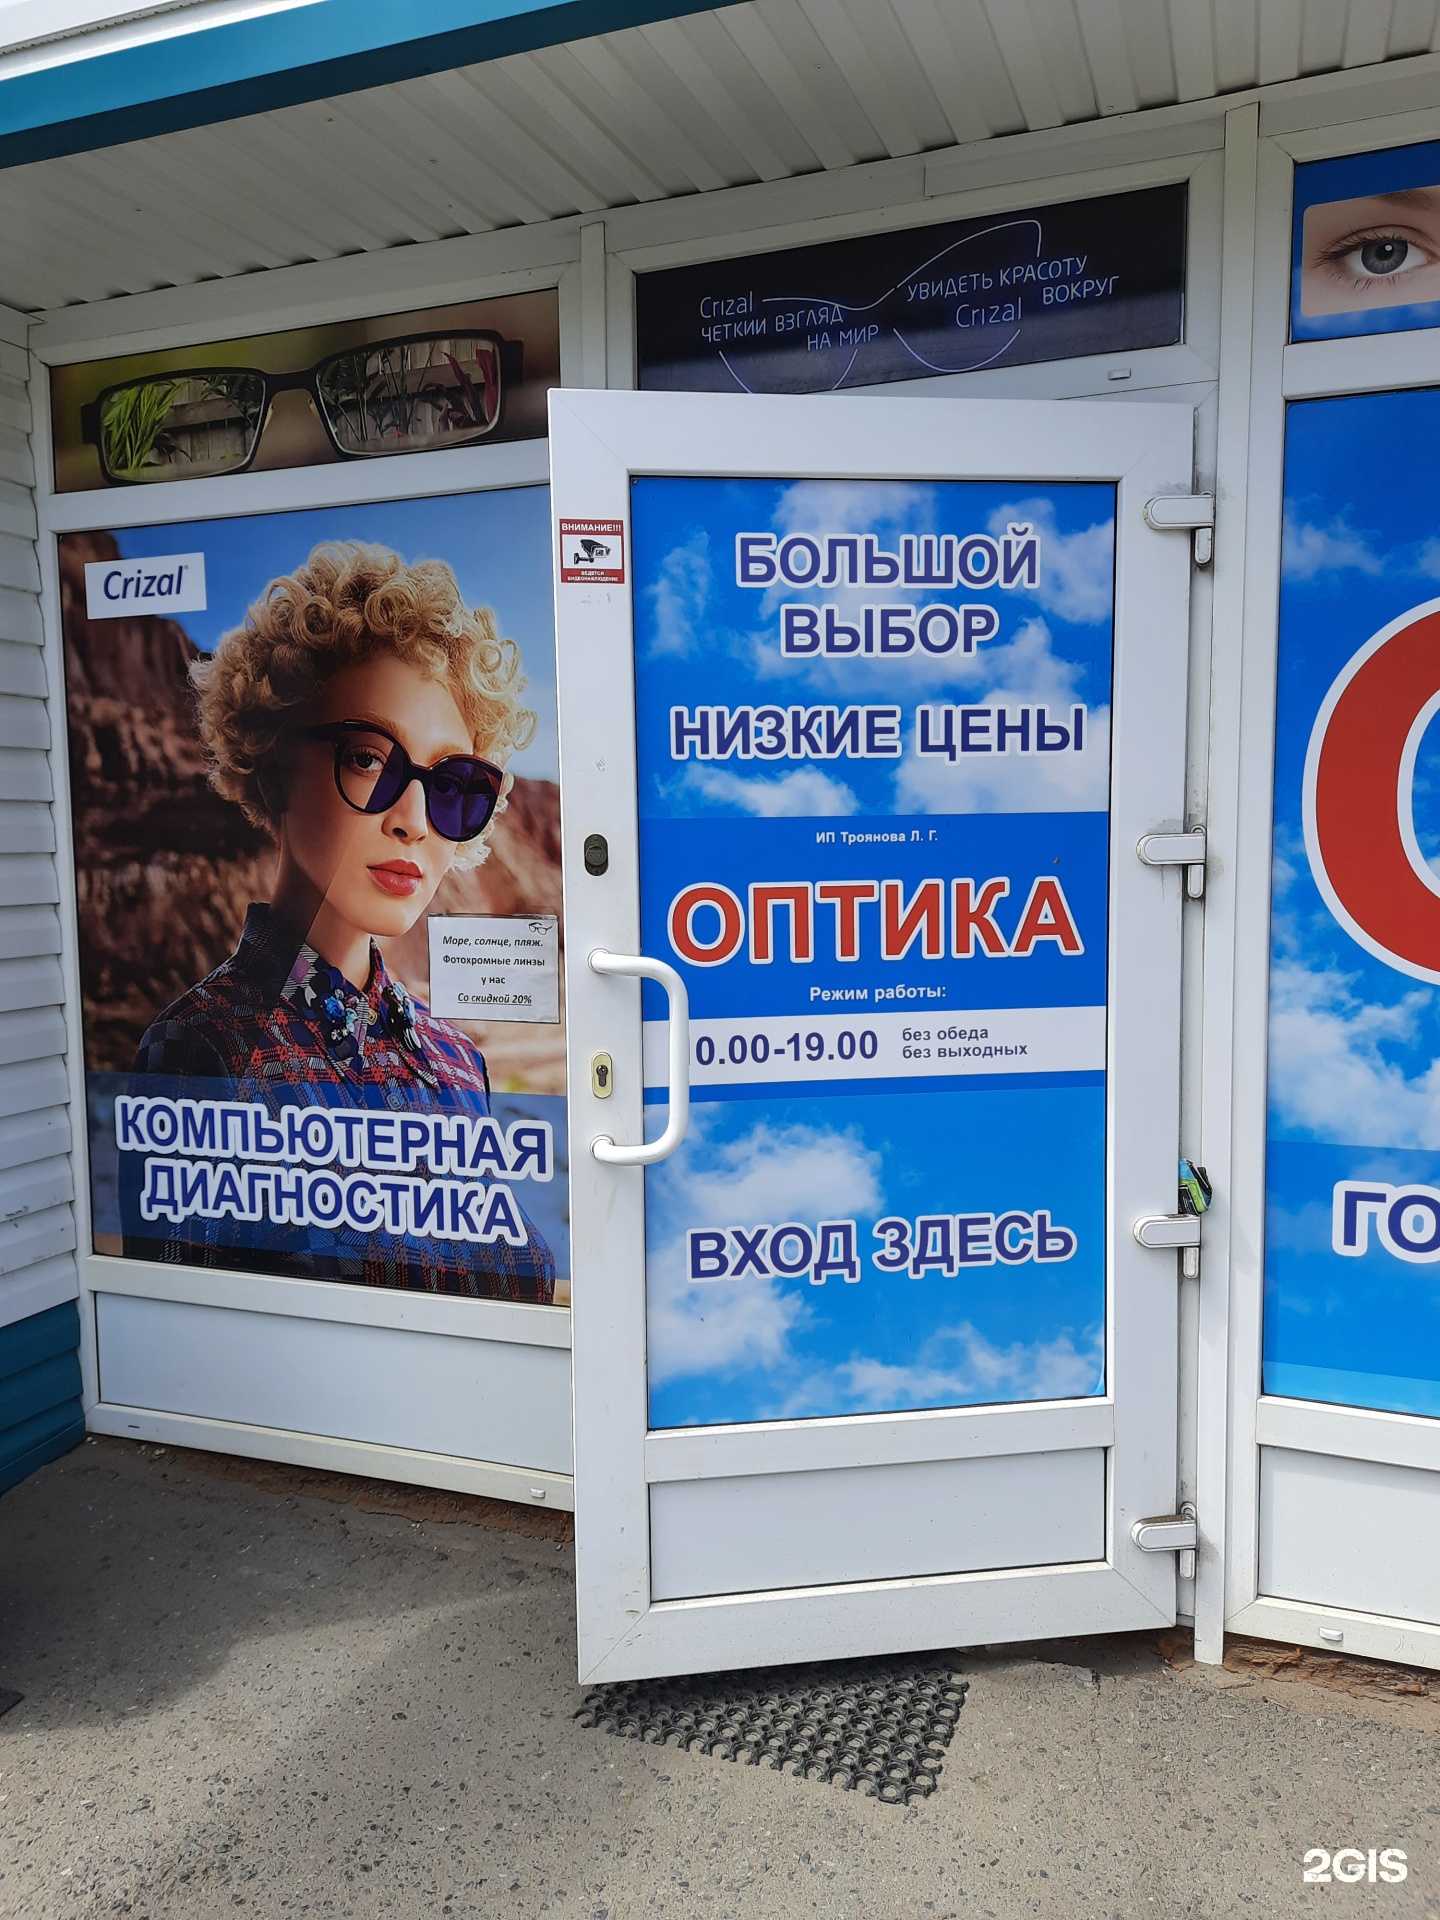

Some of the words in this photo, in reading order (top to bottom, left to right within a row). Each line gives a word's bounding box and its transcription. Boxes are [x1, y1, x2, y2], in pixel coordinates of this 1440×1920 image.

[906, 272, 993, 302] УВИДЕТЬ
[999, 254, 1088, 288] КРАСОТУ
[1042, 275, 1120, 305] ВОКРУГ
[700, 290, 753, 319] Crizal
[775, 304, 844, 332] ВЗГЛЯД
[955, 296, 1022, 328] Crizal
[807, 332, 832, 351] НА
[839, 324, 879, 346] МИР
[561, 522, 622, 532] ВНИМАНИЕ!!!
[737, 524, 1038, 588] БОЛЬШОЙ
[103, 565, 184, 601] Crizal
[782, 605, 997, 656] ВЫБОР
[672, 707, 900, 757] НИЗКИЕ
[917, 705, 1085, 764] ЦЕНЫ
[815, 832, 836, 844] ИП
[840, 831, 906, 845] Троянова
[910, 830, 924, 842] Л.
[928, 829, 939, 842] Г.
[668, 877, 1085, 967] ОПТИКА
[442, 935, 472, 947] Море,
[474, 938, 512, 948] солнце,
[514, 939, 544, 948] пляж.
[443, 954, 511, 967] Фотохромные
[513, 958, 545, 967] линзы
[481, 975, 487, 986] у
[489, 976, 506, 985] нас
[809, 985, 869, 1002] Режим
[874, 983, 947, 1003] работы:
[458, 992, 469, 1003] Со
[471, 993, 510, 1004] скидкой
[511, 994, 532, 1004] 20%
[687, 1029, 879, 1066] 0.00-19.00
[902, 1027, 931, 1041] без
[937, 1026, 989, 1041] обеда
[902, 1045, 931, 1059] без
[937, 1044, 1028, 1059] выходных
[117, 1098, 551, 1179] КОМПЬЮТЕРНАЯ
[143, 1161, 524, 1242] ДИАГНОСТИКА
[688, 1221, 858, 1282] ВХОД
[873, 1212, 1075, 1276] ЗДЕСЬ
